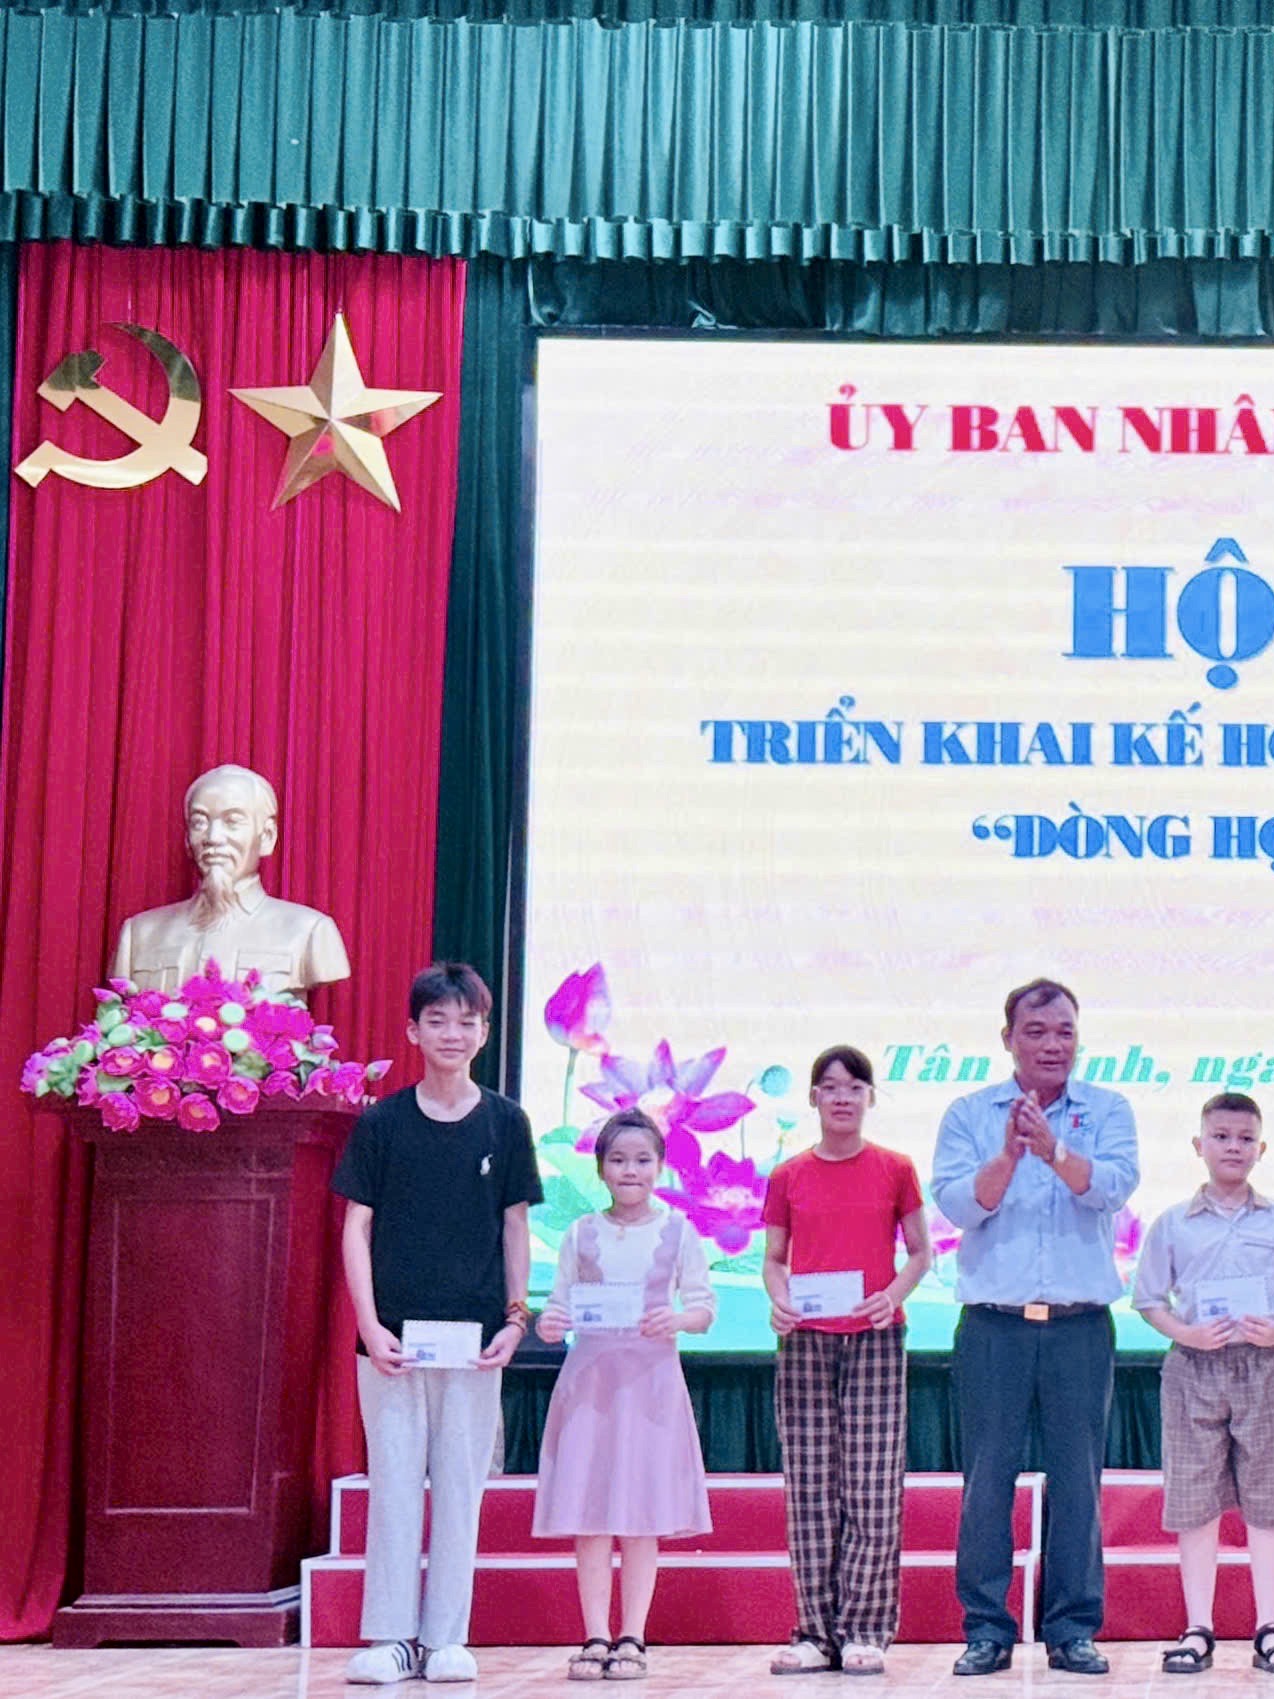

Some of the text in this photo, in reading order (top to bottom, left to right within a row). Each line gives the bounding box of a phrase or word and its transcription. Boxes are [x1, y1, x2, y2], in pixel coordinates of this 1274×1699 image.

[826, 384, 928, 452] ỦY
[947, 404, 1098, 453] BAN
[700, 695, 903, 766] TRIỂN
[922, 721, 1094, 767] KHAI
[1109, 702, 1205, 768] KẾ
[884, 1043, 991, 1082] Tân
[1070, 1044, 1172, 1084] inh,
